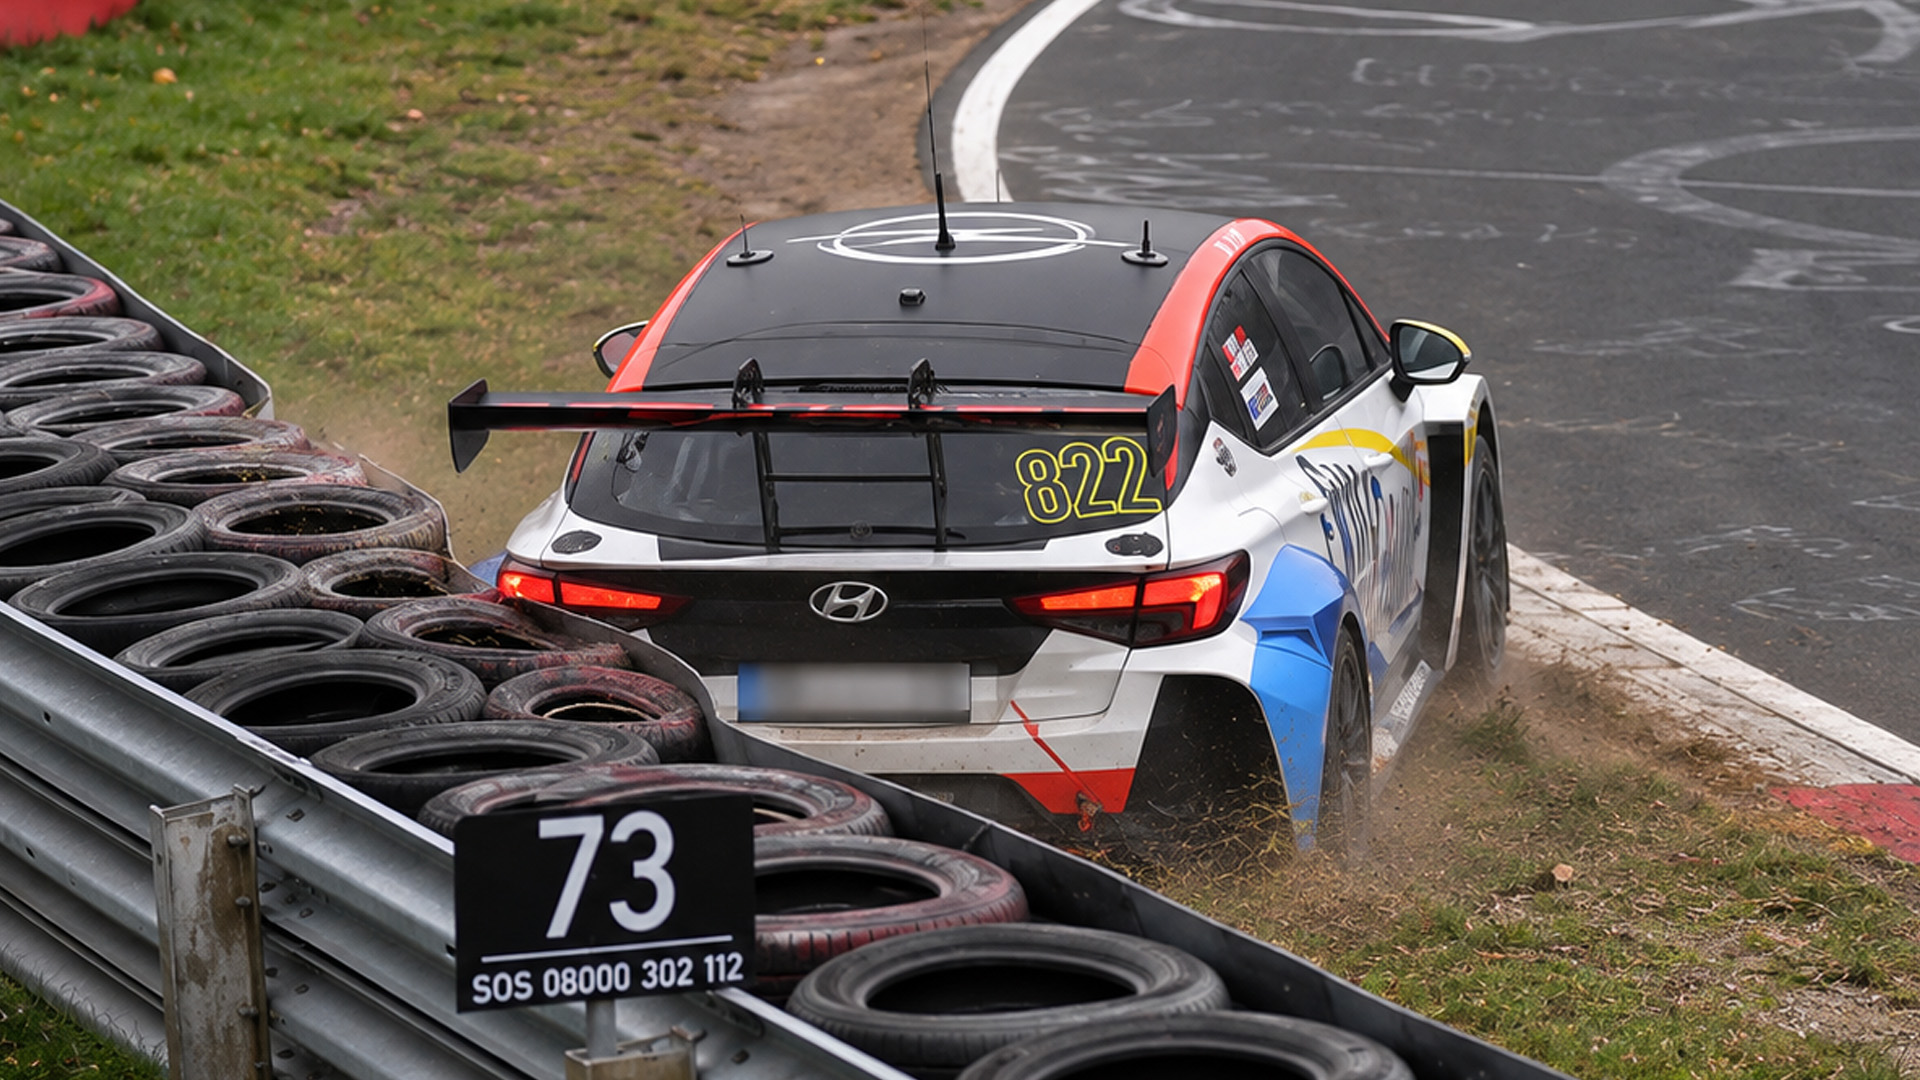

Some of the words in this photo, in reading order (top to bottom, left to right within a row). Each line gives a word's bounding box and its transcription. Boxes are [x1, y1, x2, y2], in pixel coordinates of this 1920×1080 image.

[1015, 436, 1162, 523] 822
[539, 810, 675, 938] 73
[472, 970, 533, 1004] SOS
[543, 962, 631, 998] 08000
[641, 956, 694, 990] 302
[703, 951, 744, 983] 112
